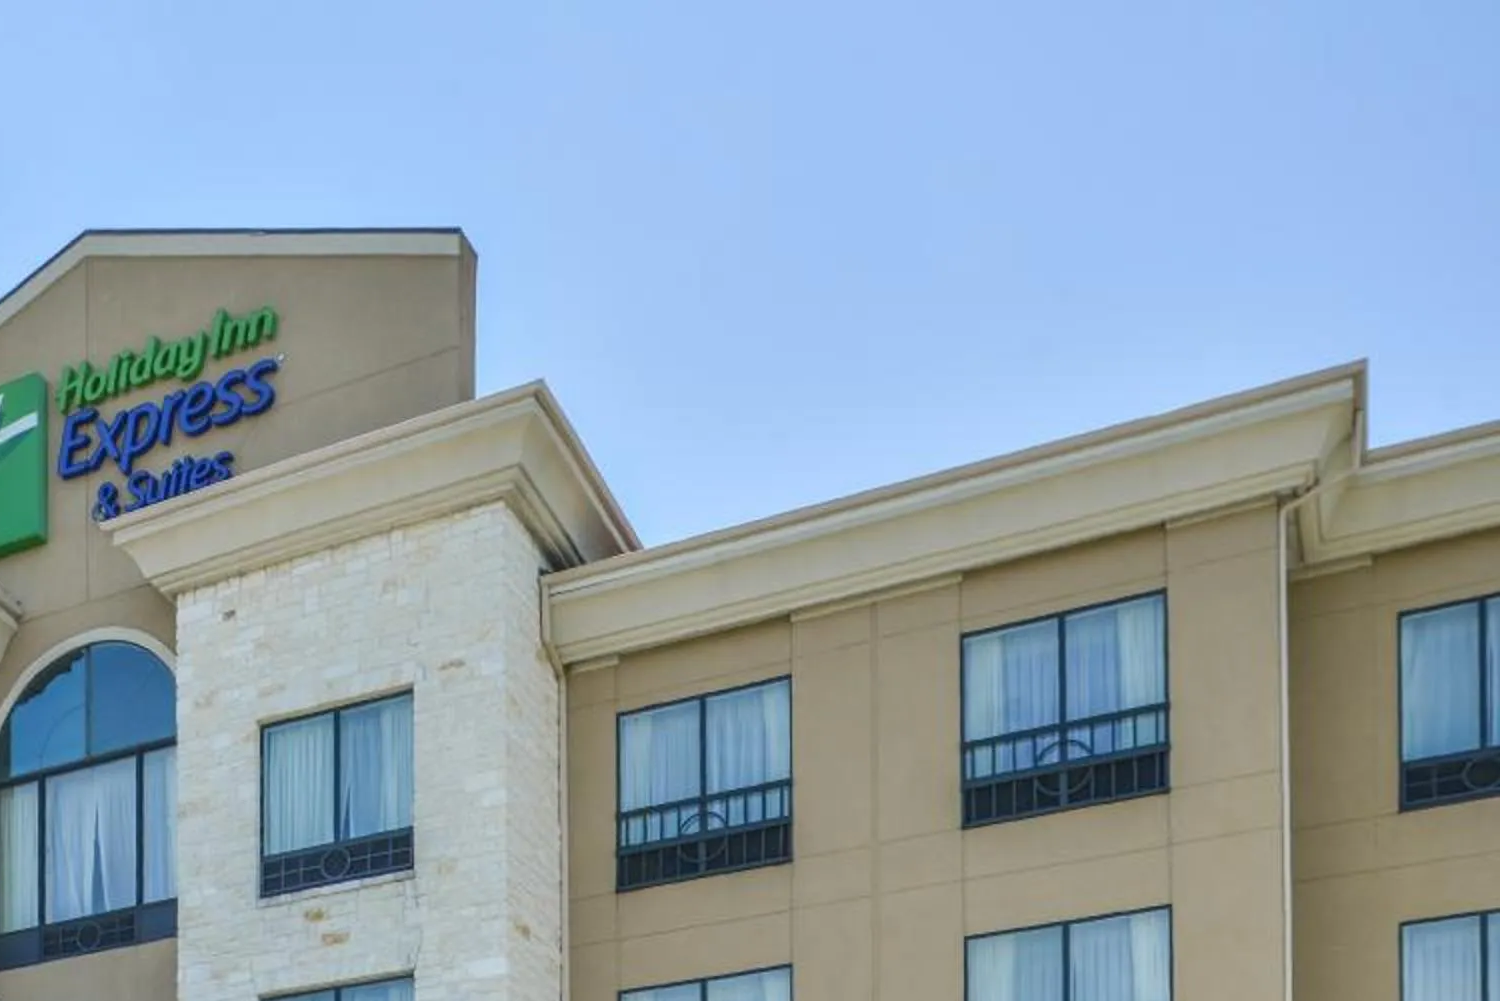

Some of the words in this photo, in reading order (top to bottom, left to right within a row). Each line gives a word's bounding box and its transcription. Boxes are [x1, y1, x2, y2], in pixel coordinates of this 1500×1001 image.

[55, 331, 209, 415] Holiday
[211, 306, 279, 359] Inn
[57, 358, 281, 480] Express
[92, 481, 121, 522] &
[125, 450, 234, 512] Suites
